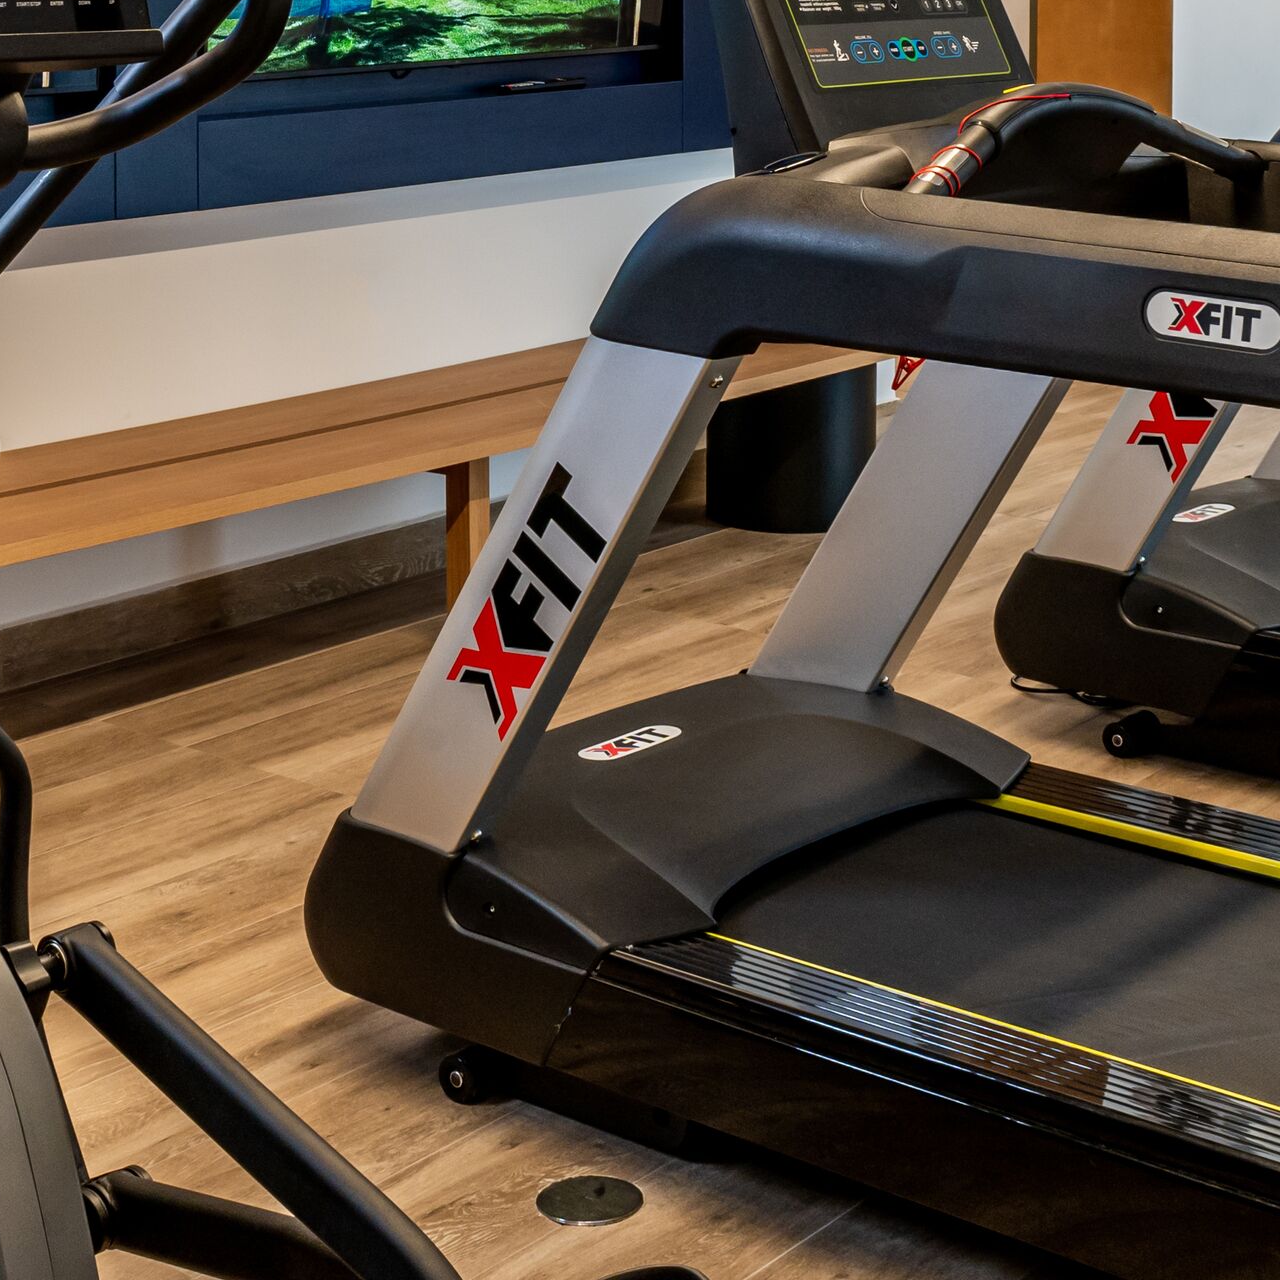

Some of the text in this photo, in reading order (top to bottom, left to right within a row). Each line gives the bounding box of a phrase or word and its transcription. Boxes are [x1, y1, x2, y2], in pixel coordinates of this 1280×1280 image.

[1168, 297, 1261, 342] XFIT
[446, 461, 607, 742] XFIT
[587, 728, 669, 758] XFIT
